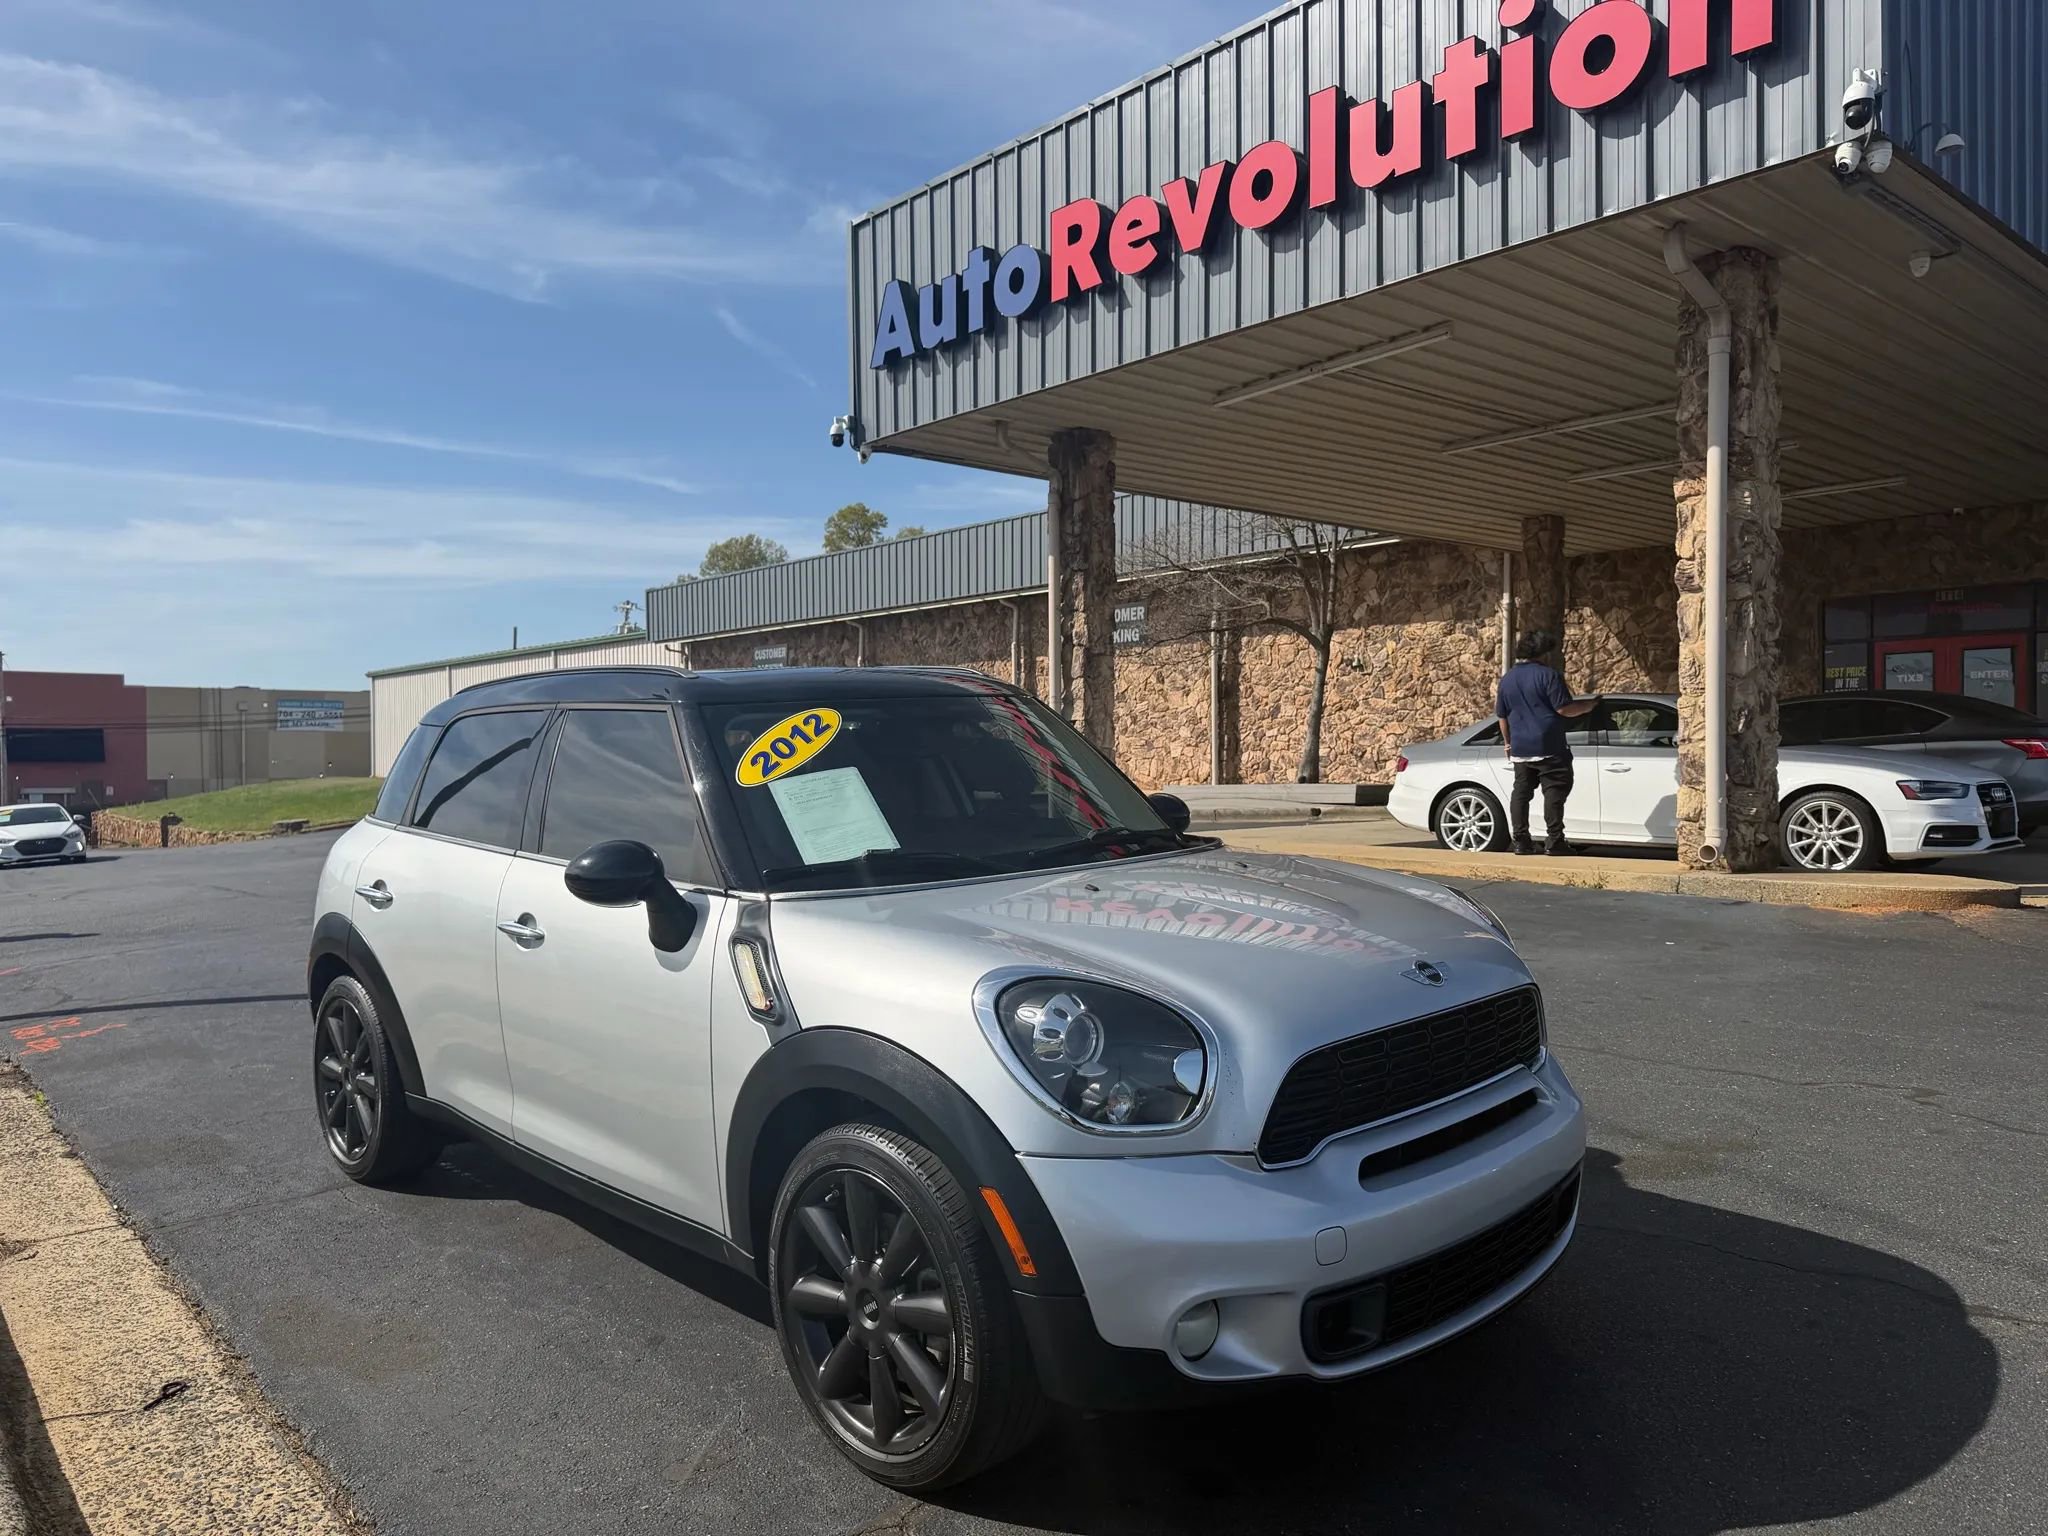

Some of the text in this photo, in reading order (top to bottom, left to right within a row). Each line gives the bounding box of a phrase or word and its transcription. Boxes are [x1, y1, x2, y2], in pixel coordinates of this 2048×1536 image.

[754, 647, 786, 660] CUSTOMER
[1826, 666, 1867, 678] BEST PRICE
[1969, 669, 2009, 679] ENTER
[1835, 677, 1860, 688] IN THE
[750, 713, 833, 779] 2012
[863, 1300, 878, 1315] MINI
